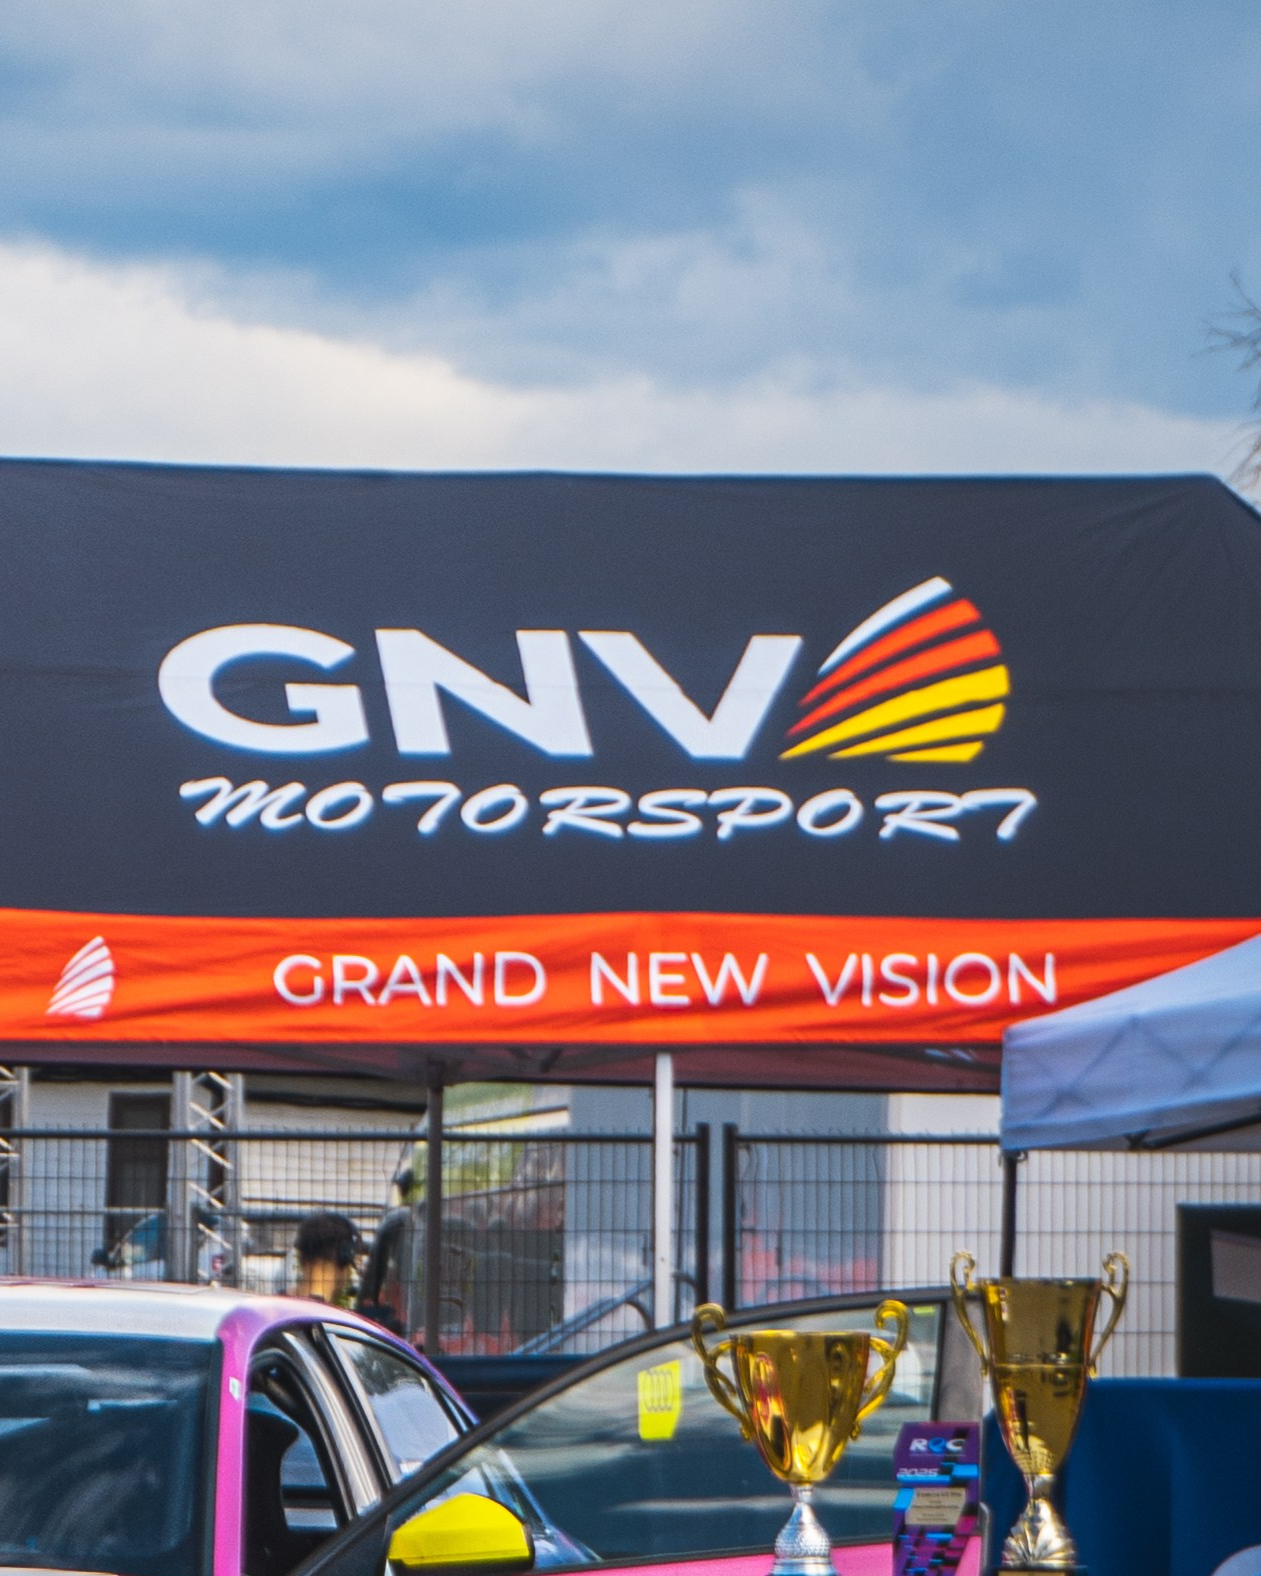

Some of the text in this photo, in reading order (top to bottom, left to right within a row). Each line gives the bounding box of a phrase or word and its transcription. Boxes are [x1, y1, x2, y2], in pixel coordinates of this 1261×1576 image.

[157, 623, 804, 759] GNV
[179, 778, 1037, 841] MOTORSPORT
[273, 951, 1057, 1006] GRAND NEW VISION
